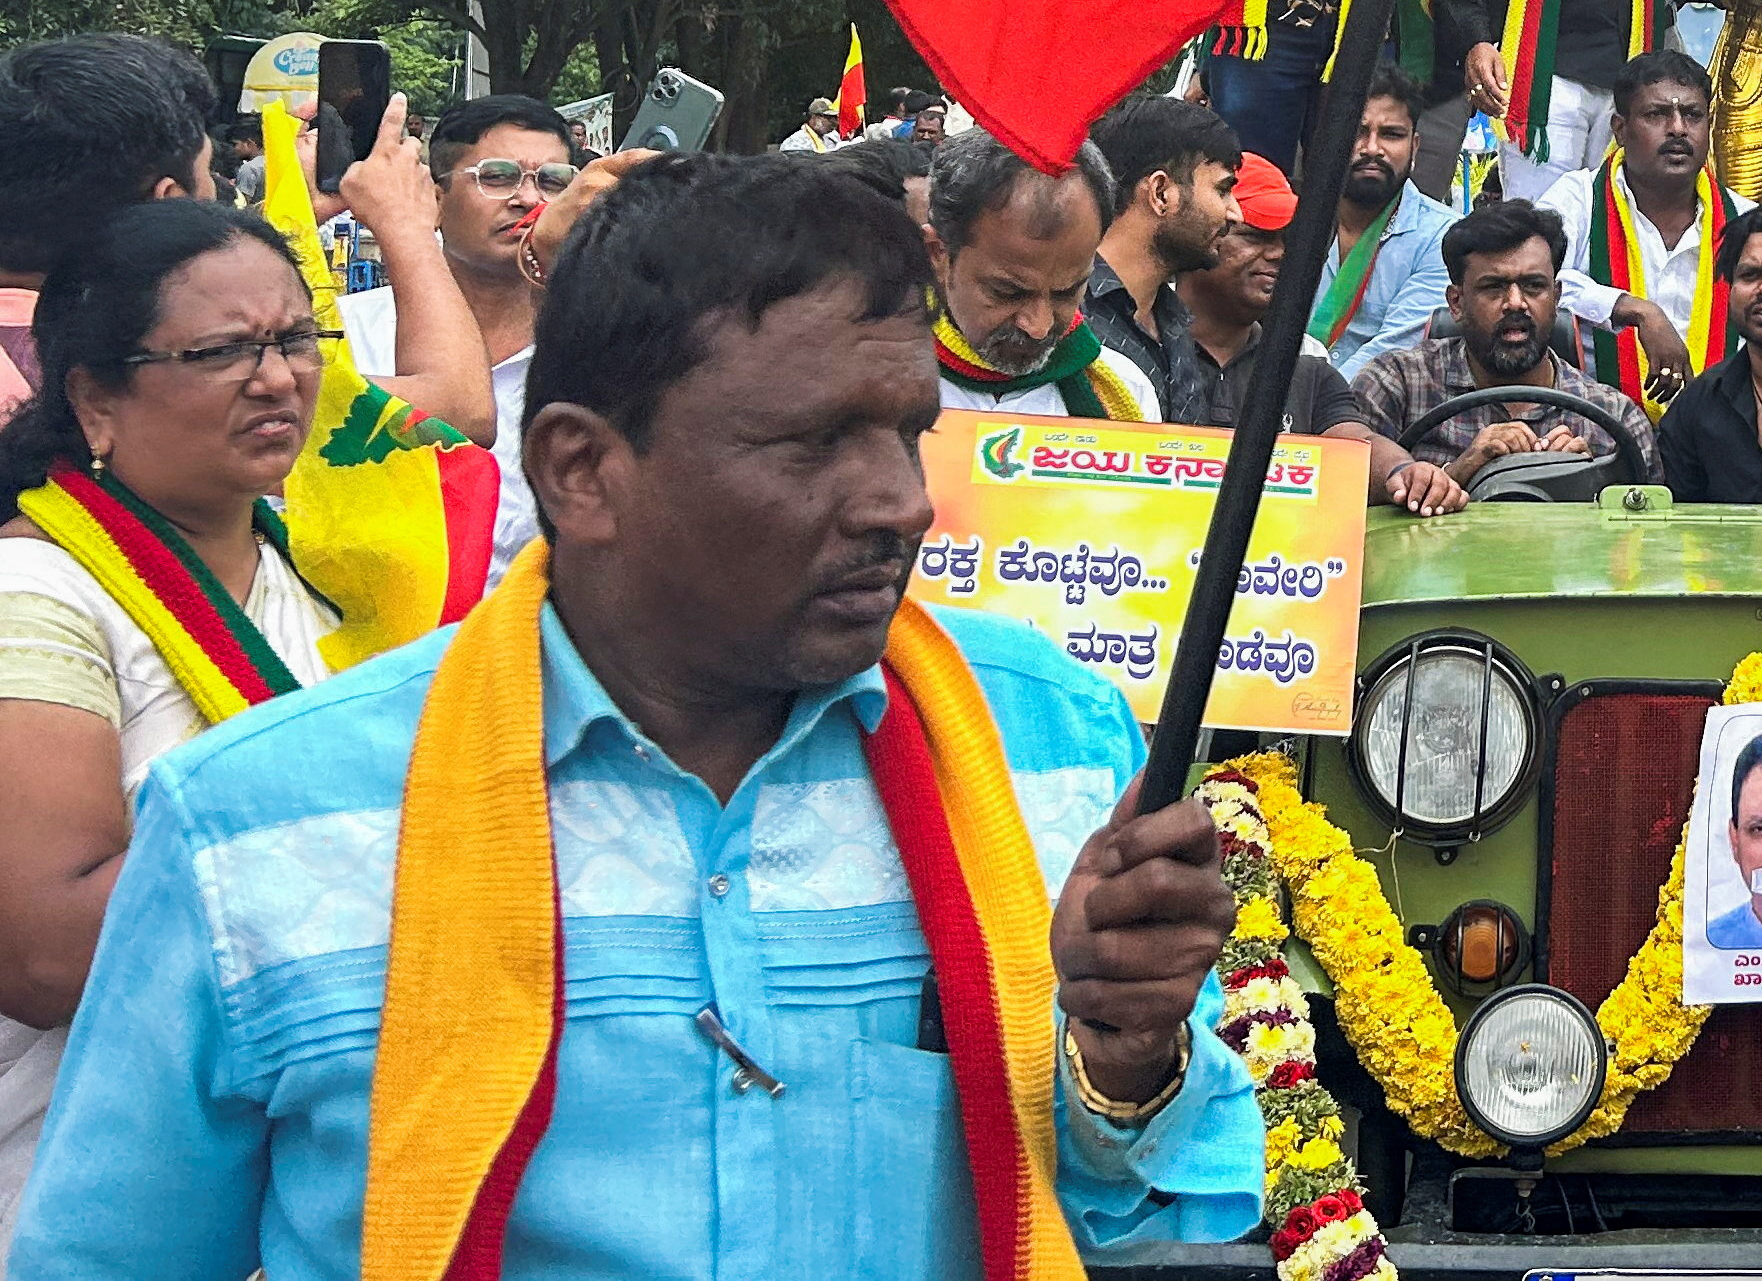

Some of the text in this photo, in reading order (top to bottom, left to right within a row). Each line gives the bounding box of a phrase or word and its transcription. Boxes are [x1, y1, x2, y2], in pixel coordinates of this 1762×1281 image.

[1033, 446, 1130, 472] ಜಯ
[921, 536, 979, 593] ರಕ್ತ
[1067, 621, 1157, 679] ಮಾತ್ರ
